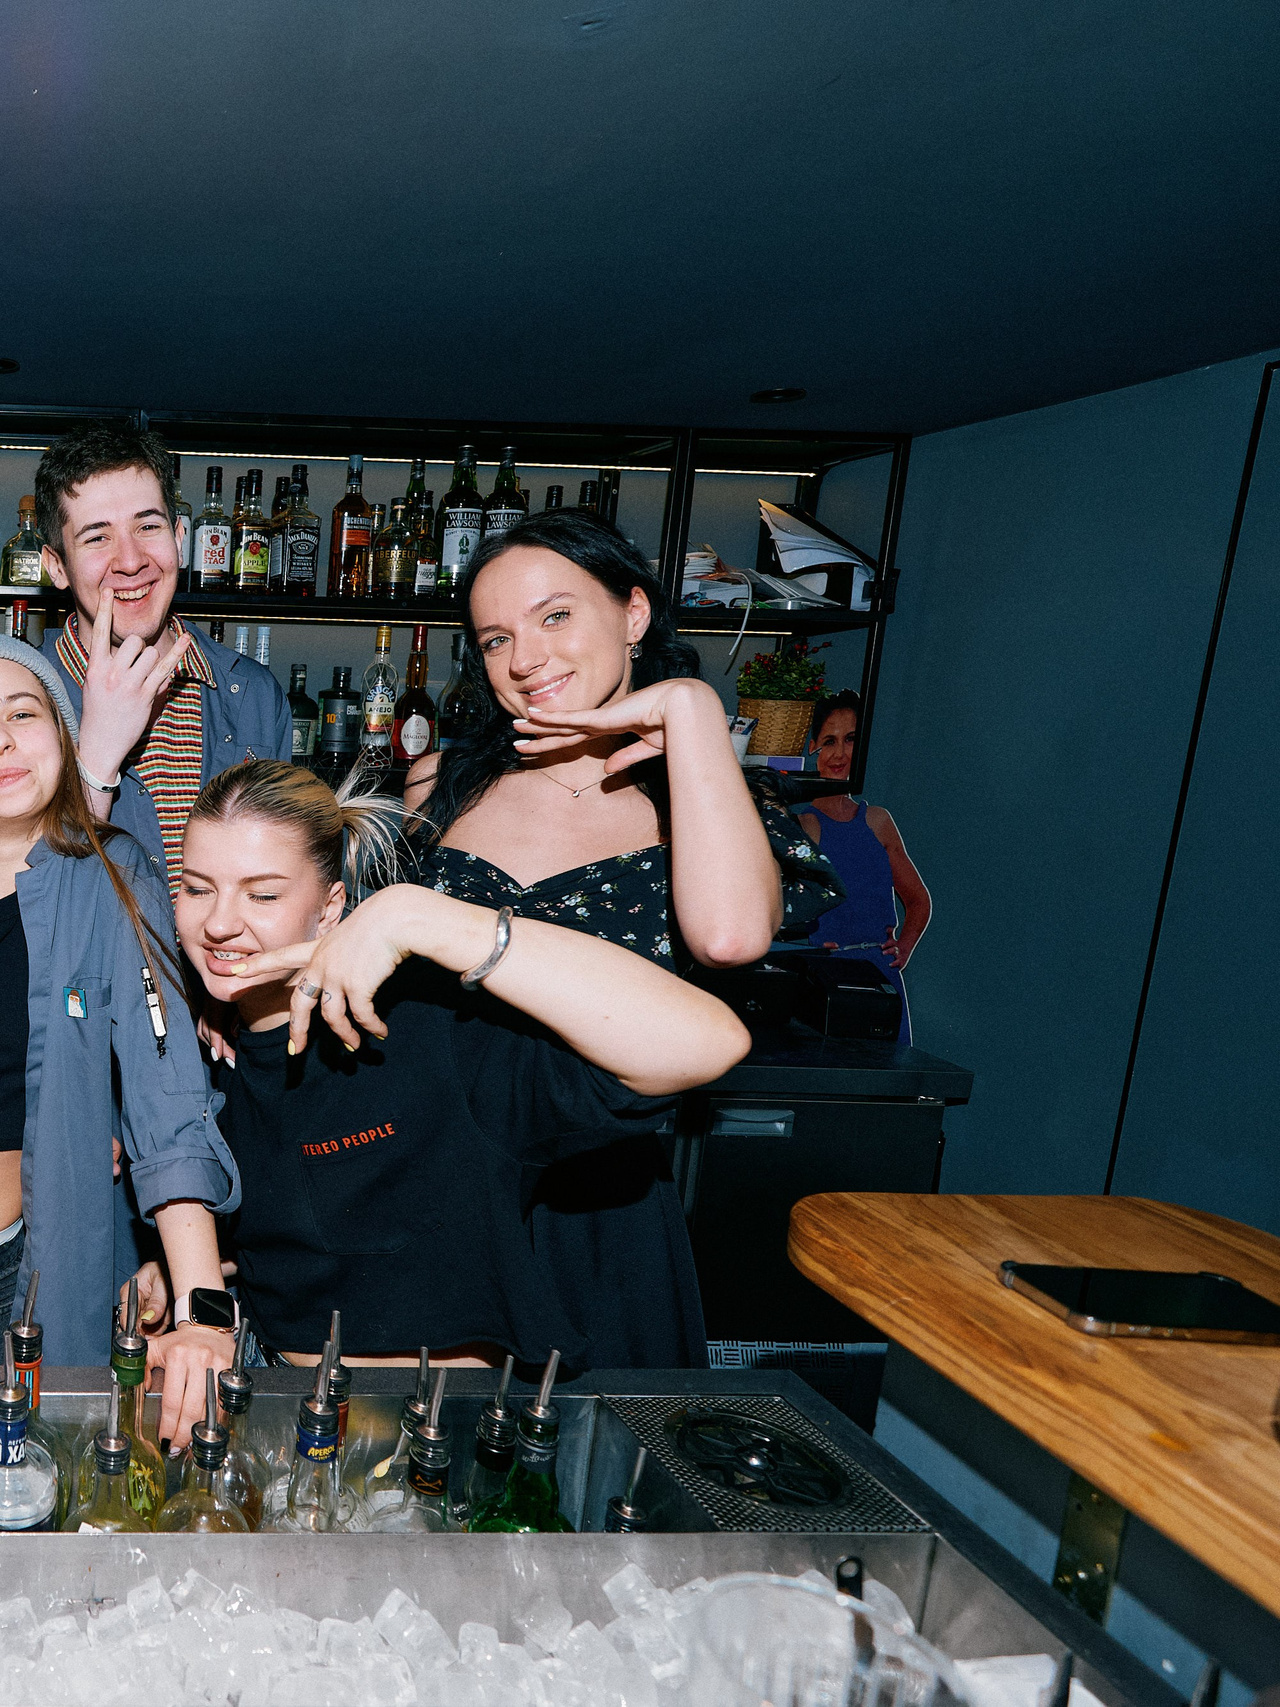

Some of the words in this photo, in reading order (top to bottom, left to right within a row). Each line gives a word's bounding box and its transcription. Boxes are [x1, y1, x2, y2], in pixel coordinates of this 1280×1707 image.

[449, 512, 481, 521] WILLIAM
[489, 514, 523, 522] WILLIAM
[288, 533, 300, 545] JACK
[204, 547, 226, 558] red
[203, 557, 226, 565] STAG
[366, 685, 395, 702] BRUGAL
[326, 713, 336, 724] 10
[302, 1140, 340, 1156] TEREO
[342, 1123, 395, 1149] PEOPLE
[307, 1444, 335, 1457] APEROL
